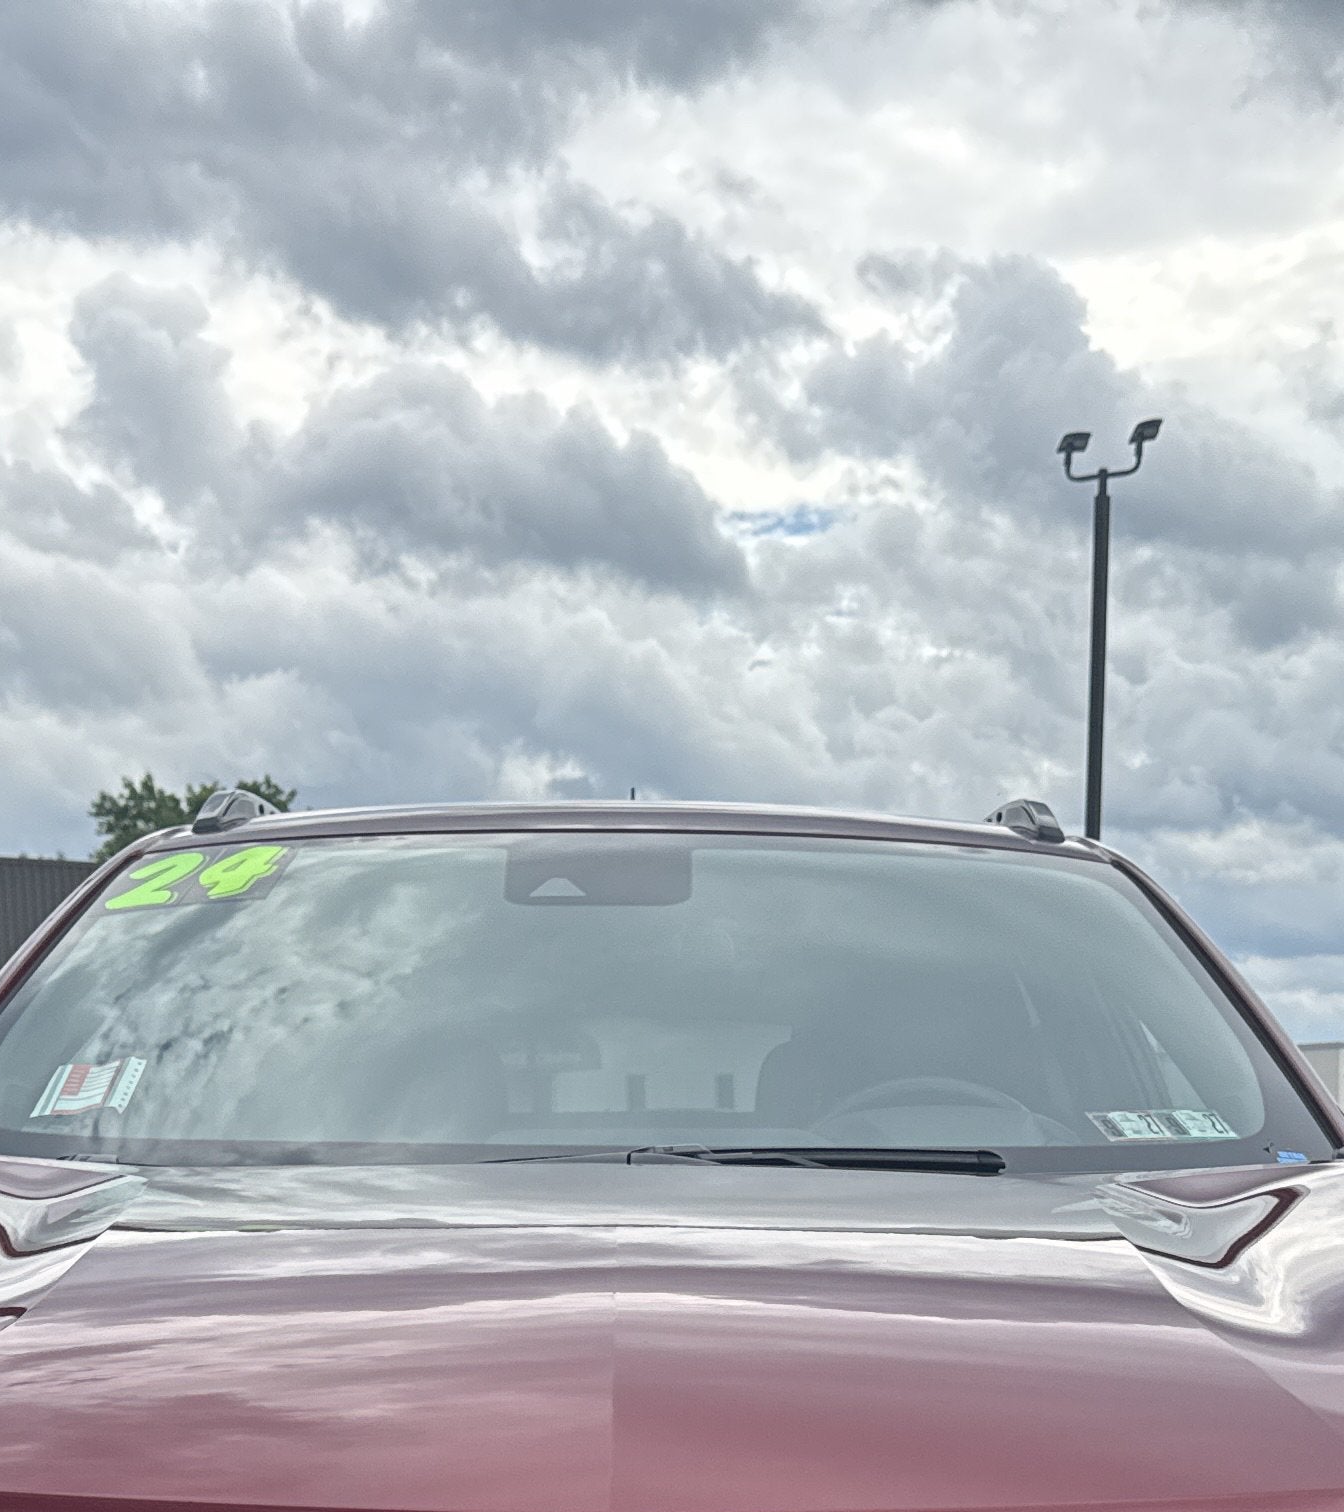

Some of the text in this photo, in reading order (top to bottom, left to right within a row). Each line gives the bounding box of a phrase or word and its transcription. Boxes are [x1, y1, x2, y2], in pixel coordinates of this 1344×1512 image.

[104, 844, 284, 910] 24
[1137, 1113, 1166, 1137] 27
[1202, 1112, 1230, 1134] 27
